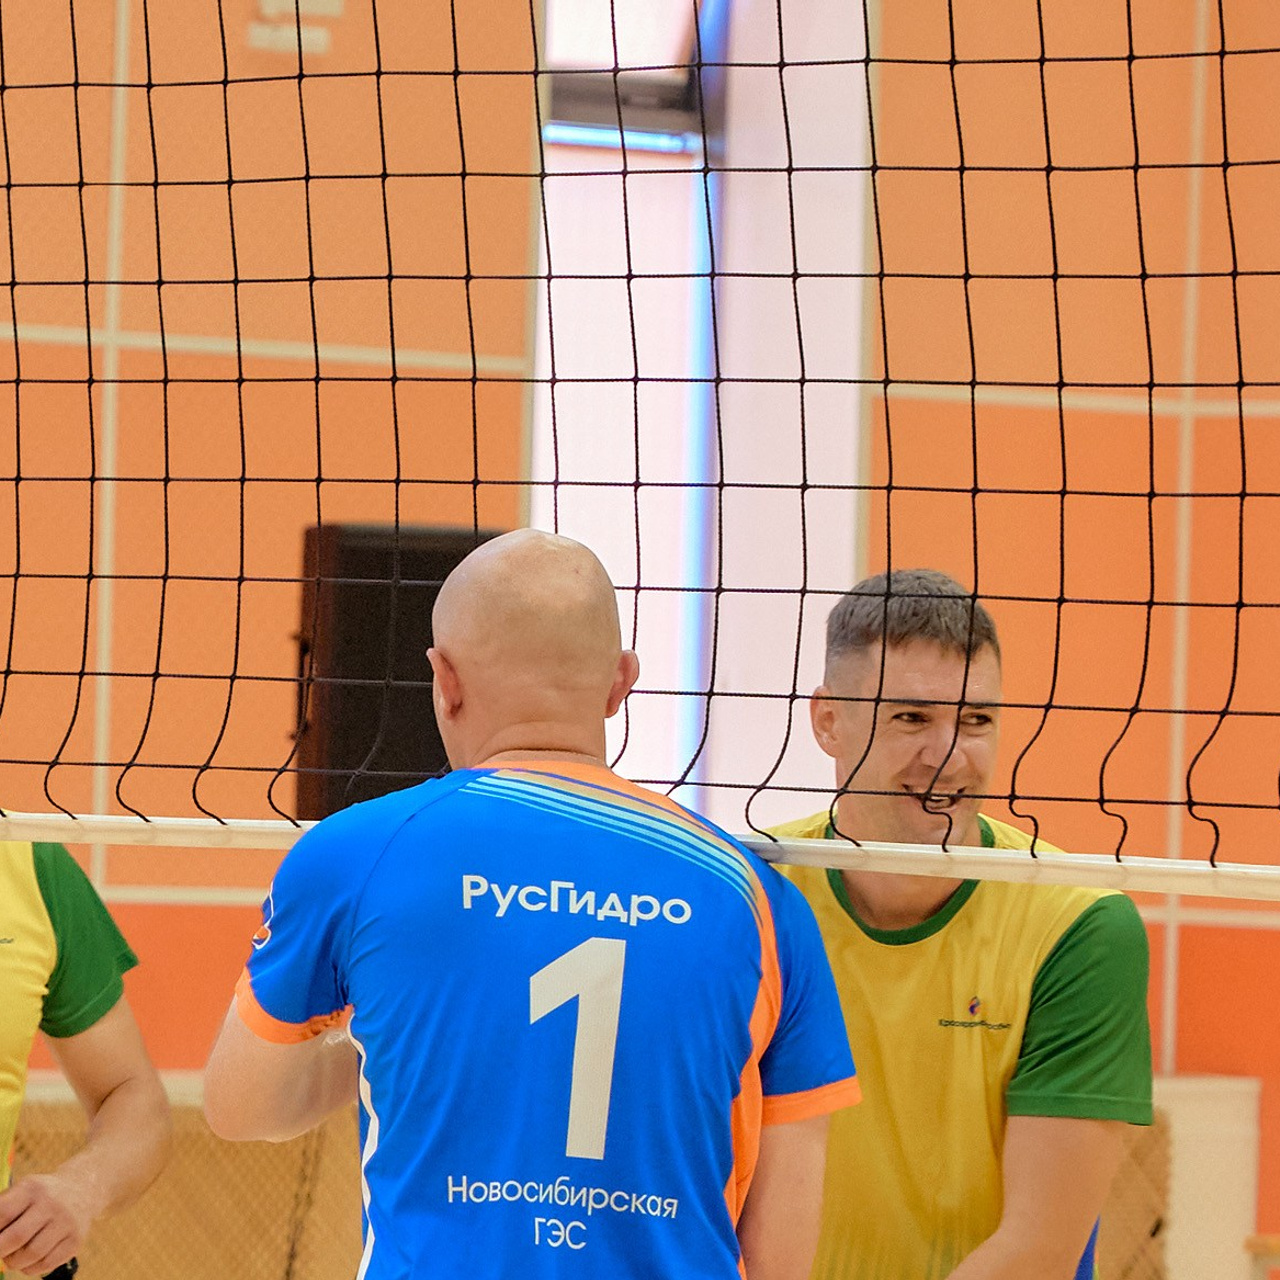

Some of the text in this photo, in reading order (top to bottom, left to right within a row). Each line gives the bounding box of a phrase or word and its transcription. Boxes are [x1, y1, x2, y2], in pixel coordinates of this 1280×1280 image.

[462, 874, 692, 926] РусГидро
[530, 937, 626, 1160] 1
[447, 1175, 678, 1218] Новосибирская
[534, 1217, 587, 1250] ГЭС
